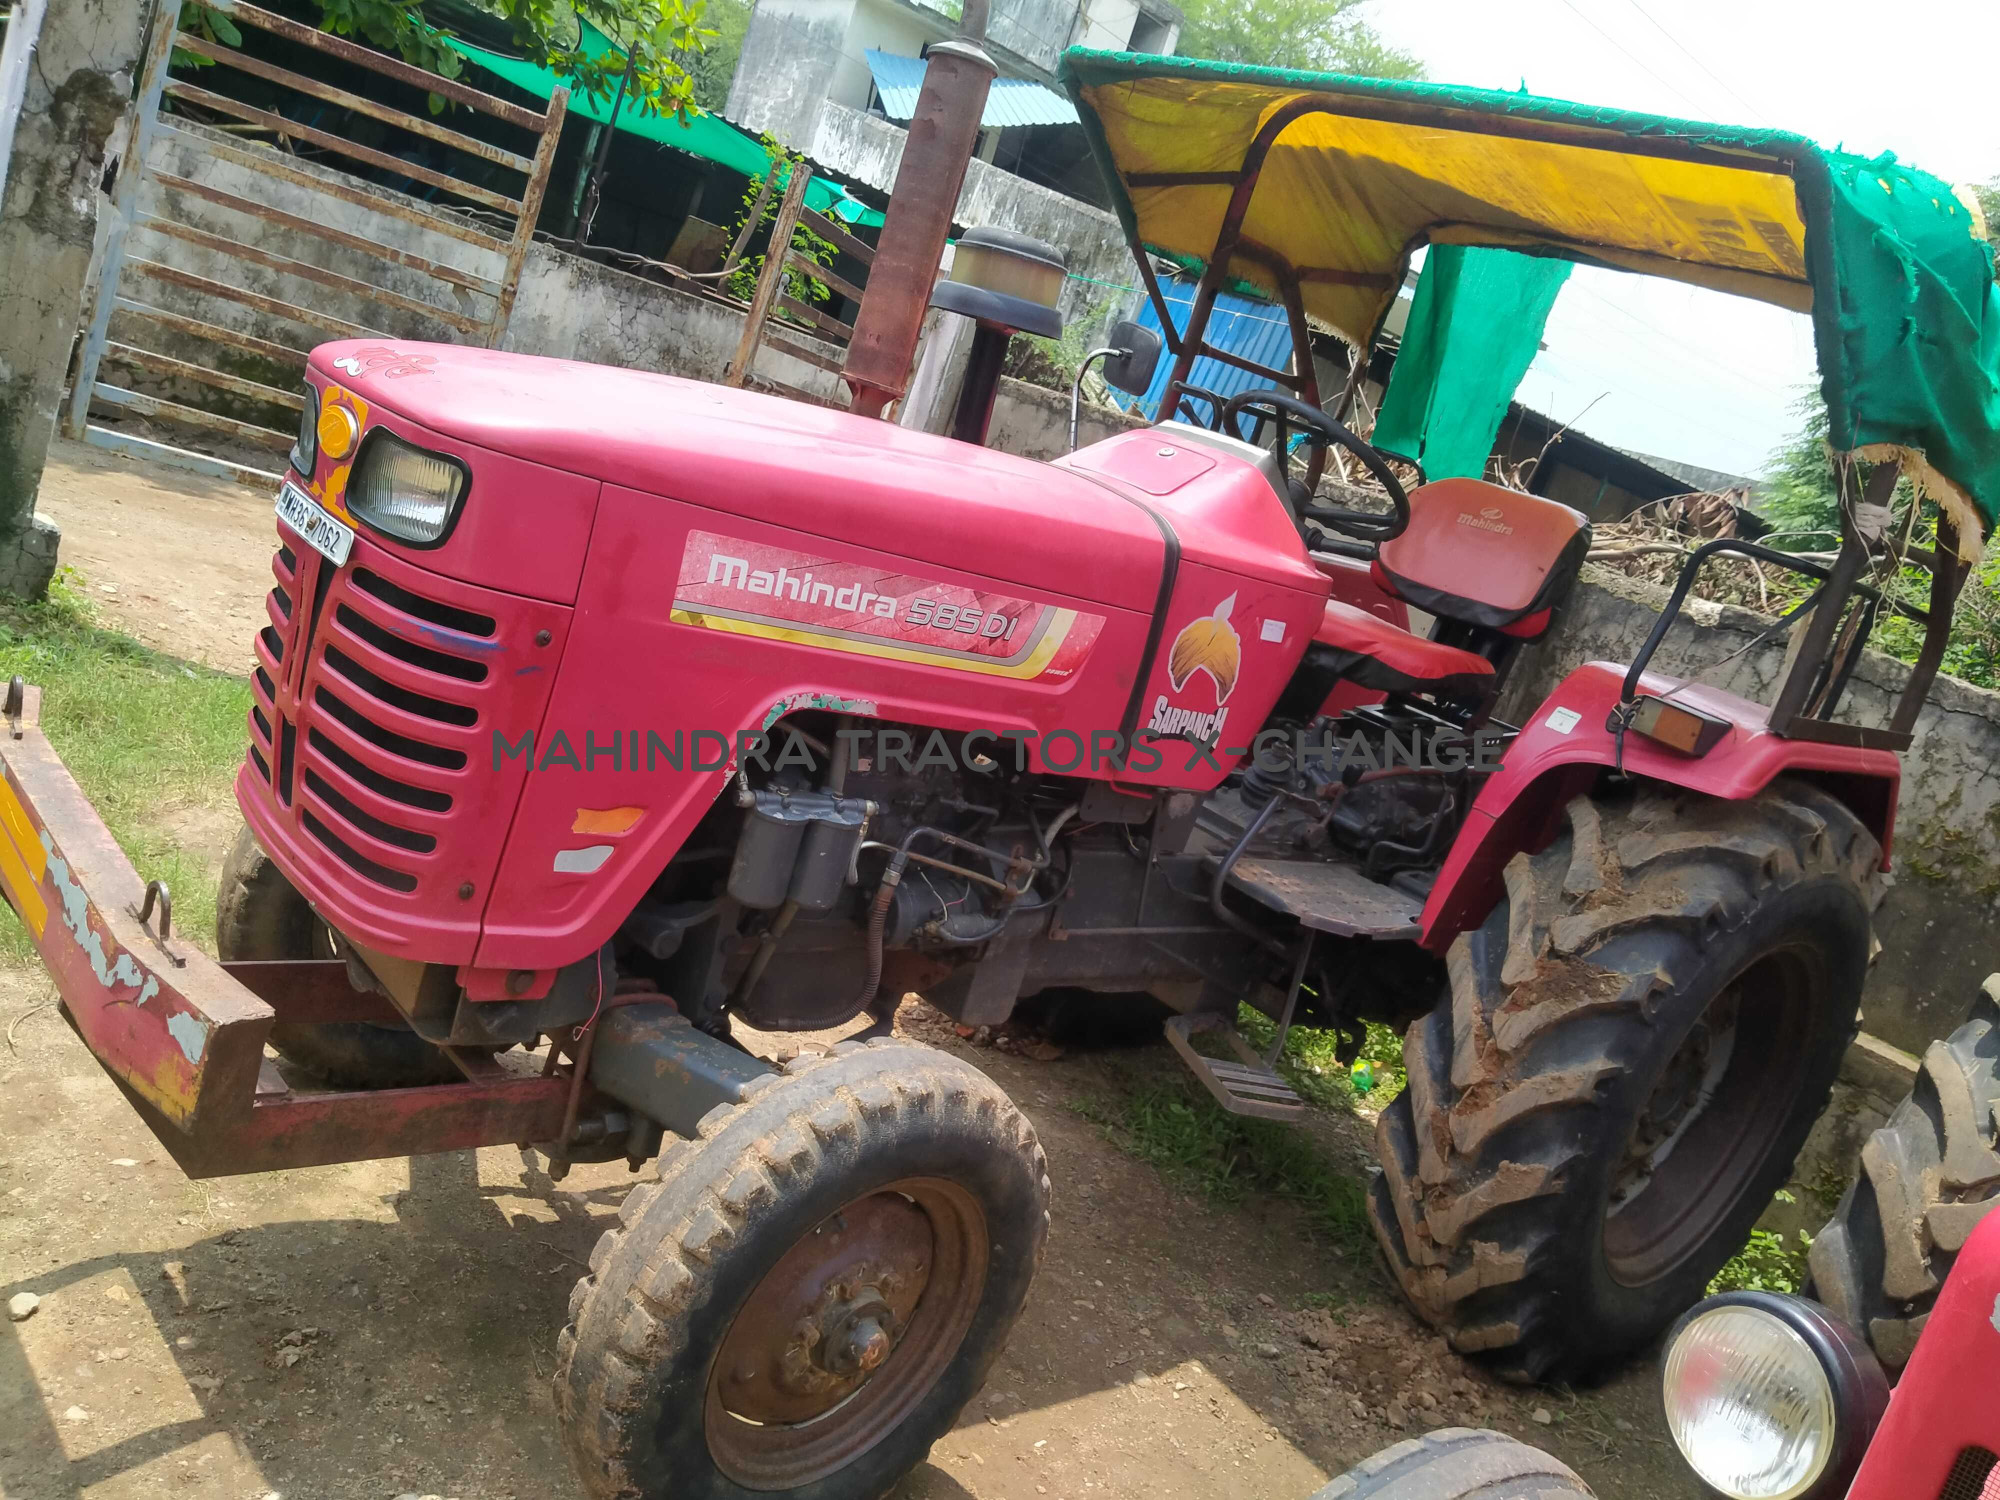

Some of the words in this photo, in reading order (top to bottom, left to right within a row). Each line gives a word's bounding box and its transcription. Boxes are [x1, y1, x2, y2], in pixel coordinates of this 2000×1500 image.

[1457, 513, 1513, 535] Mahindra
[706, 553, 897, 619] Mahindra
[1147, 695, 1229, 750] SARPANCH
